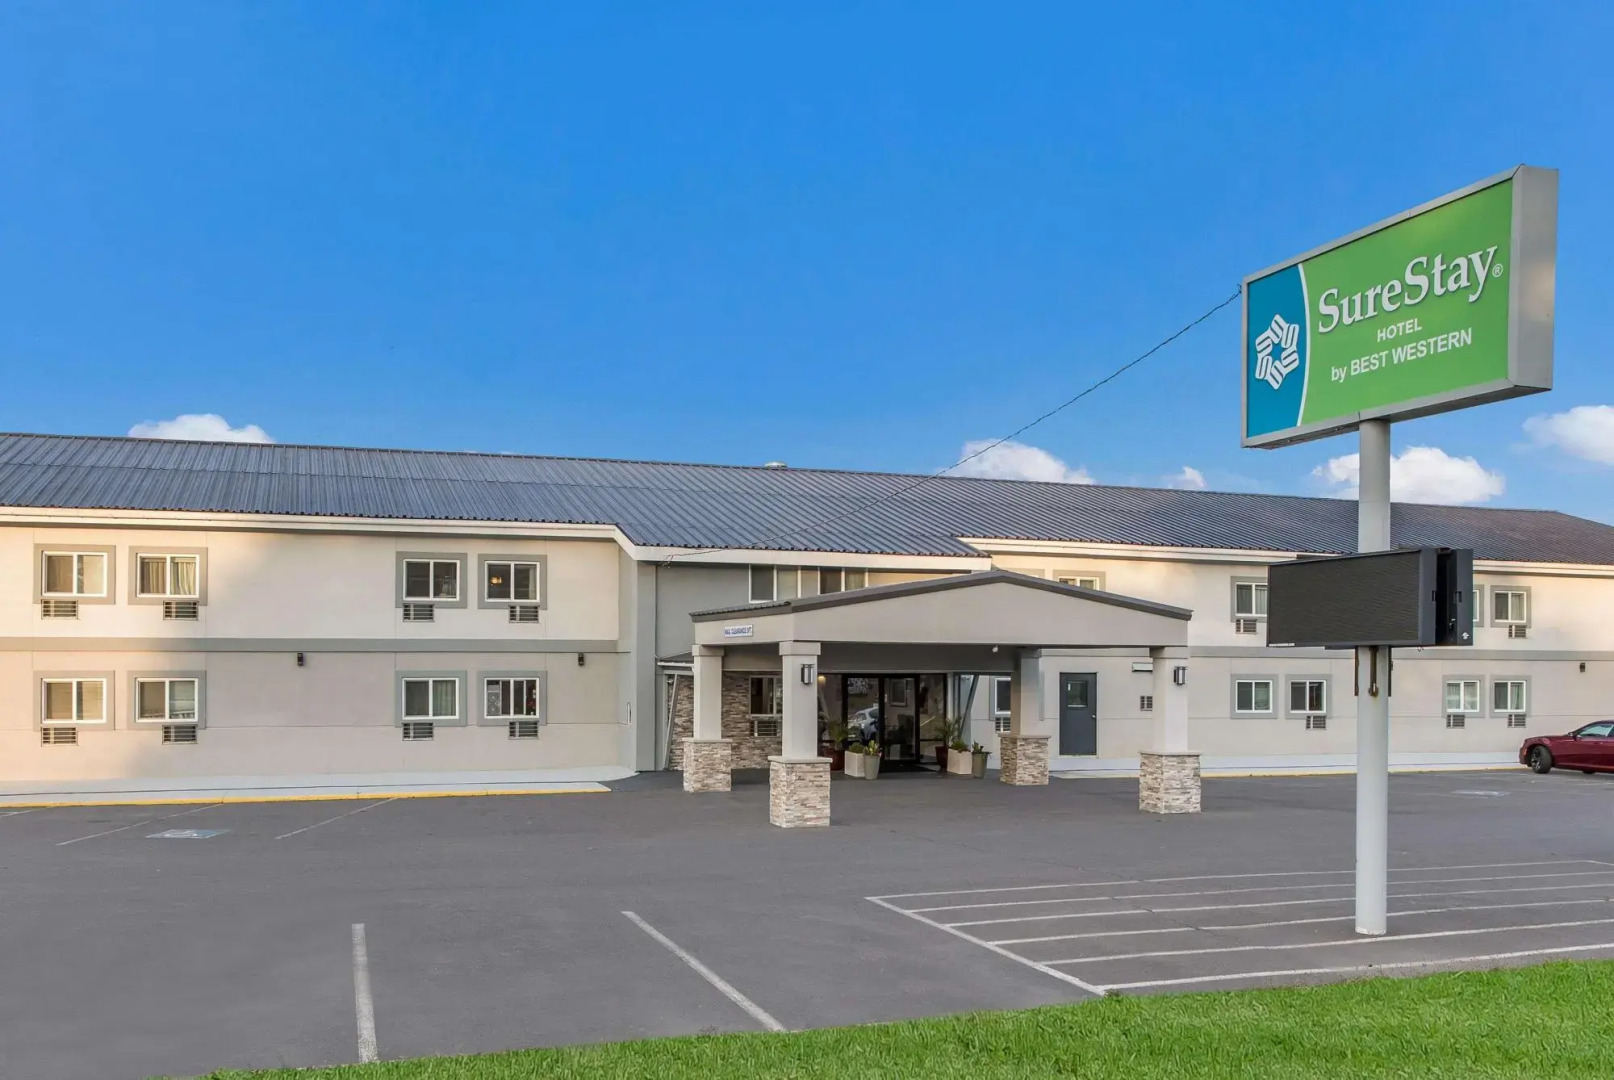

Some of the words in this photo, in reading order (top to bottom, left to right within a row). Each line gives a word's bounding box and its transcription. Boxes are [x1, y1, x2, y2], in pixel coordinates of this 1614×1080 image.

[1377, 318, 1422, 342] HOTEL
[1331, 366, 1347, 383] by
[1350, 351, 1388, 376] BEST
[1391, 328, 1472, 364] WESTERN
